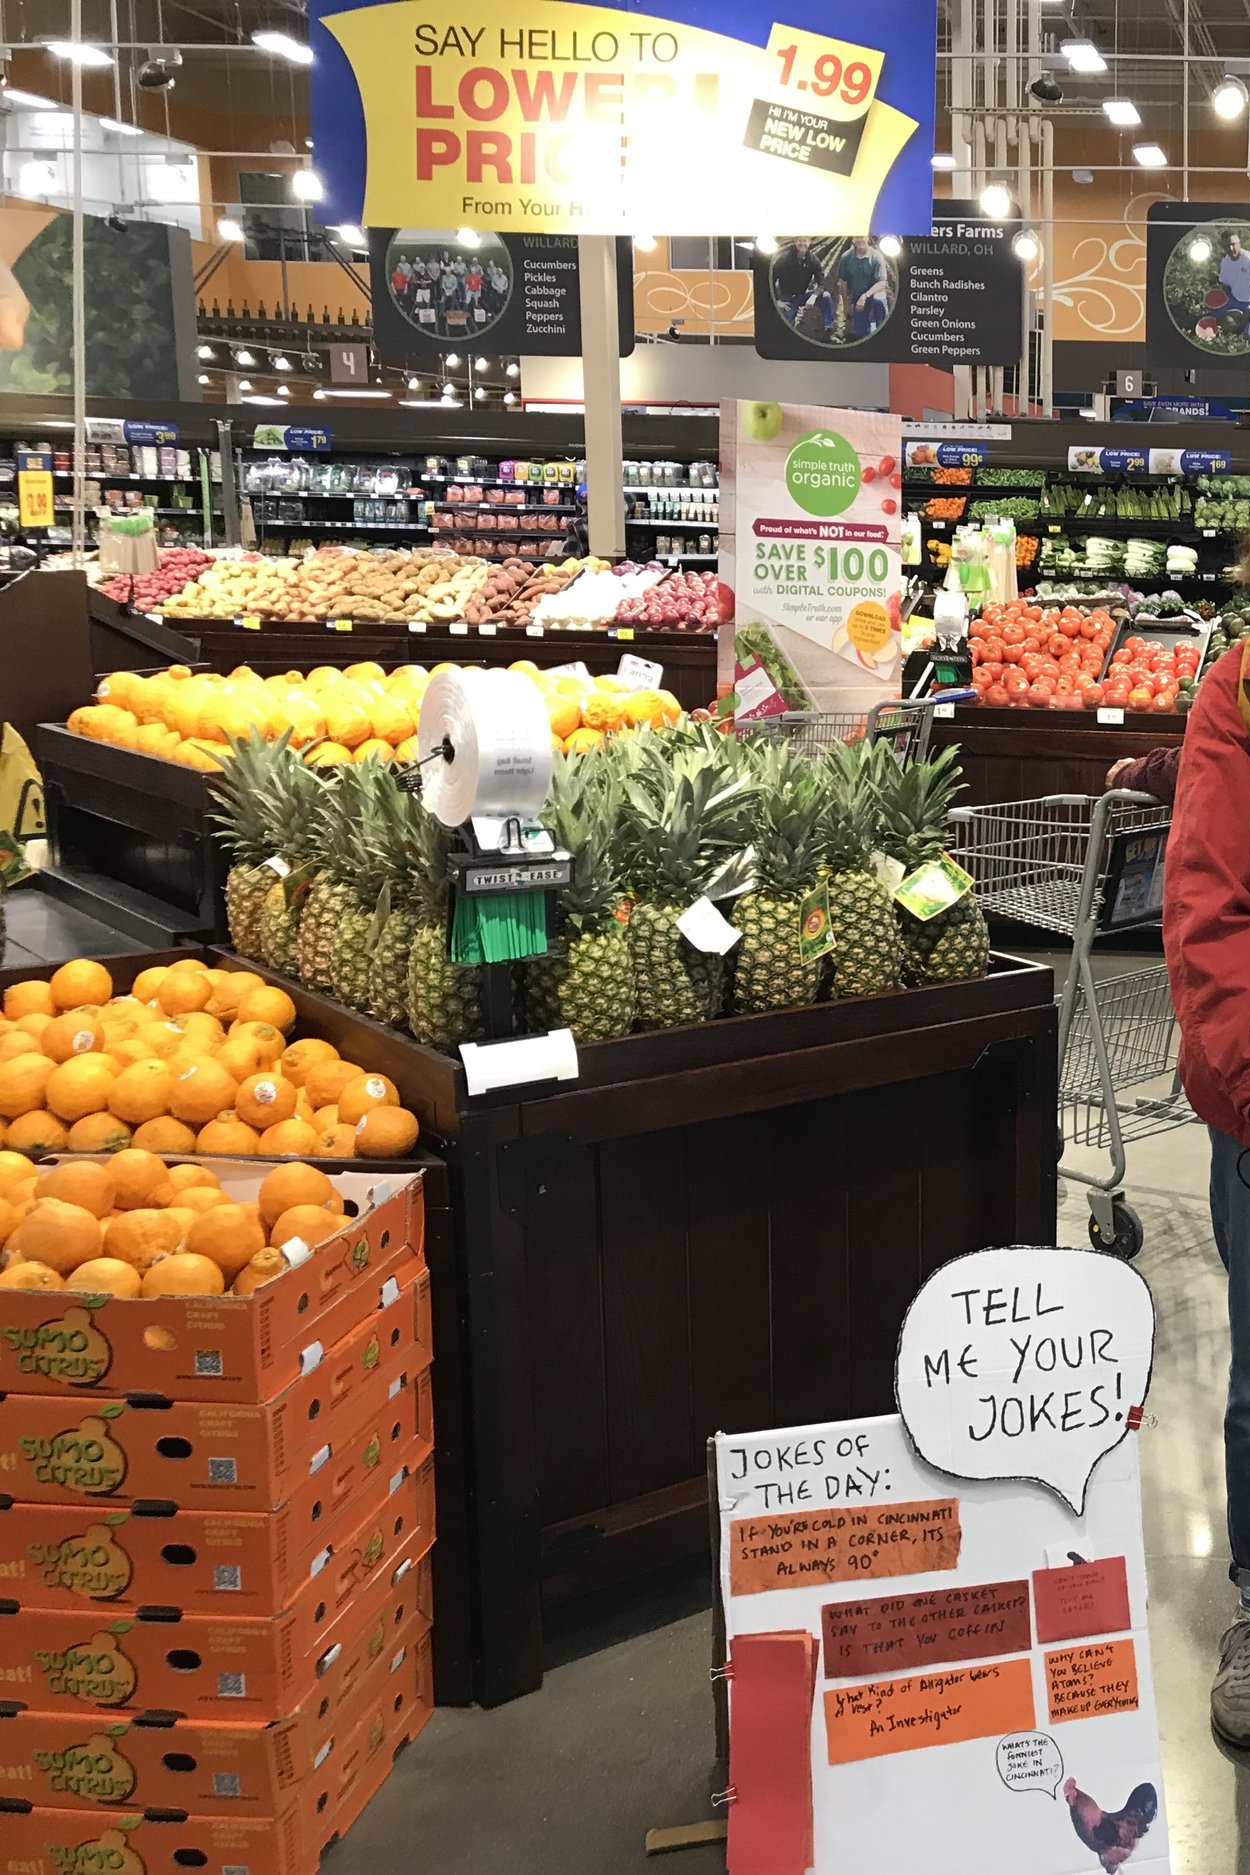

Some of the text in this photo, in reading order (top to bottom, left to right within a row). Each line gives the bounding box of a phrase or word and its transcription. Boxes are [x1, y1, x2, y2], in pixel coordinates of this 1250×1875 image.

[414, 24, 680, 63] SAY HELLO TO
[776, 44, 871, 105] 1.99
[800, 114, 828, 131] YOUR
[764, 118, 846, 153] NEW LOW
[759, 134, 812, 162] PRICE
[462, 197, 512, 215] From
[519, 199, 562, 216] Your
[957, 224, 1004, 239] Farms
[974, 244, 993, 255] OH
[523, 260, 577, 271] Cucumbers
[910, 266, 944, 276] Greens
[524, 273, 557, 283] Pickles
[910, 280, 985, 290] Bunch Radishes
[524, 286, 567, 297] Cabbage
[910, 293, 948, 302] Cilantro
[525, 298, 560, 310] Squash
[910, 306, 944, 317] Parsley
[525, 311, 564, 323] Peppers
[911, 319, 976, 330] Green Onions
[526, 324, 566, 335] Zucchini
[911, 332, 965, 342] Cucumbers
[911, 345, 981, 356] Green Peppers
[343, 353, 355, 374] 4
[1124, 376, 1134, 392] 6
[792, 460, 855, 473] simple truth
[792, 472, 855, 488] organic
[760, 524, 782, 533] Proud
[819, 526, 844, 538] NOT
[845, 529, 852, 537] in
[756, 543, 889, 582] SAVE $100
[754, 564, 807, 581] OVER
[753, 584, 886, 598] with DIGITAL COUPONS!
[477, 870, 559, 885] TWIST EASE
[951, 1283, 1064, 1325] TELL
[924, 1329, 1118, 1387] ME YOUR
[968, 1372, 1122, 1441] JOKES!
[730, 1435, 869, 1478] JOKES OF
[755, 1467, 890, 1508] THE DAY:
[812, 1517, 846, 1532] COLD
[852, 1514, 867, 1525] IN
[877, 1507, 952, 1525] CINCINNATI
[742, 1527, 944, 1559] STAND IN A CORNER, ITS
[777, 1558, 836, 1575] ALWAYS
[829, 1606, 870, 1619] WHAT
[881, 1601, 904, 1614] DID
[946, 1589, 998, 1604] CASKET
[922, 1607, 967, 1623] OTHER
[1049, 1652, 1073, 1664] WHY
[1050, 1658, 1112, 1678] YOU BELIEVE
[901, 1680, 913, 1693] of
[1099, 1680, 1129, 1692] THEY
